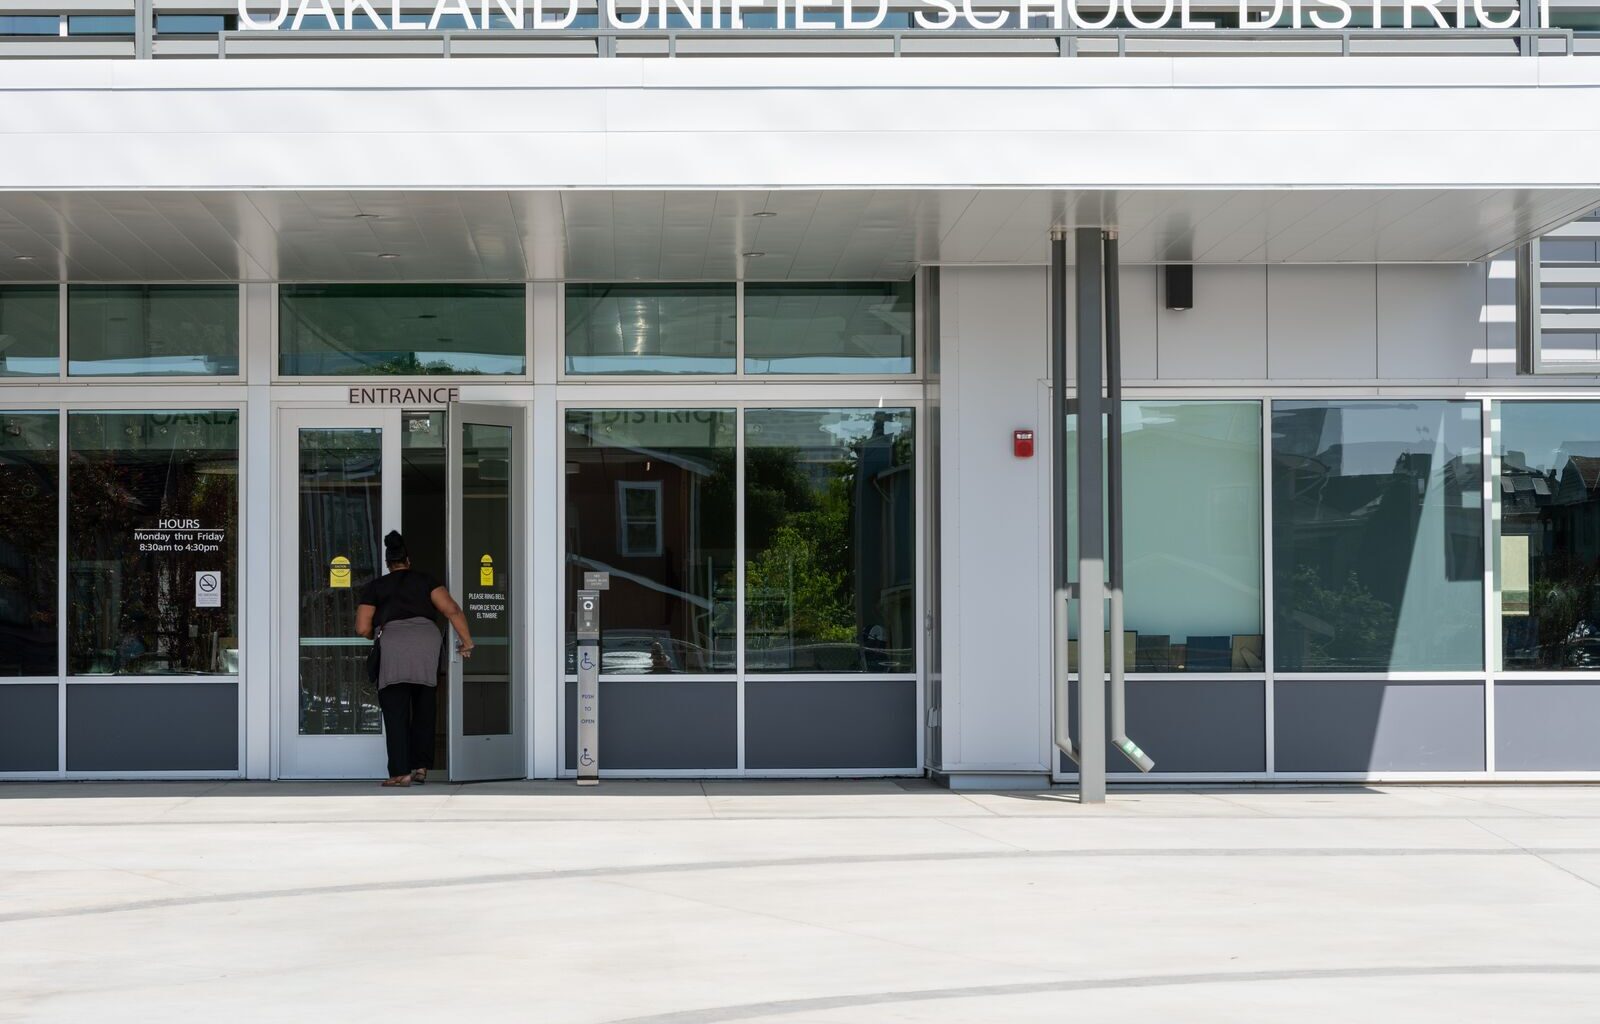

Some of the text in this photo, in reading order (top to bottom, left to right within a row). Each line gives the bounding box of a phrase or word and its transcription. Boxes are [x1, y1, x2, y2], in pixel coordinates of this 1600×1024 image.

[237, 0, 578, 30] OAKLAND
[606, 0, 888, 29] UNIFIED
[914, 0, 1216, 29] SCHOOL
[349, 388, 459, 403] ENTRANCE
[158, 519, 200, 529] HOURS
[134, 532, 225, 542] Monday thru Friday
[139, 543, 219, 553] 8:30am to 4:30pm
